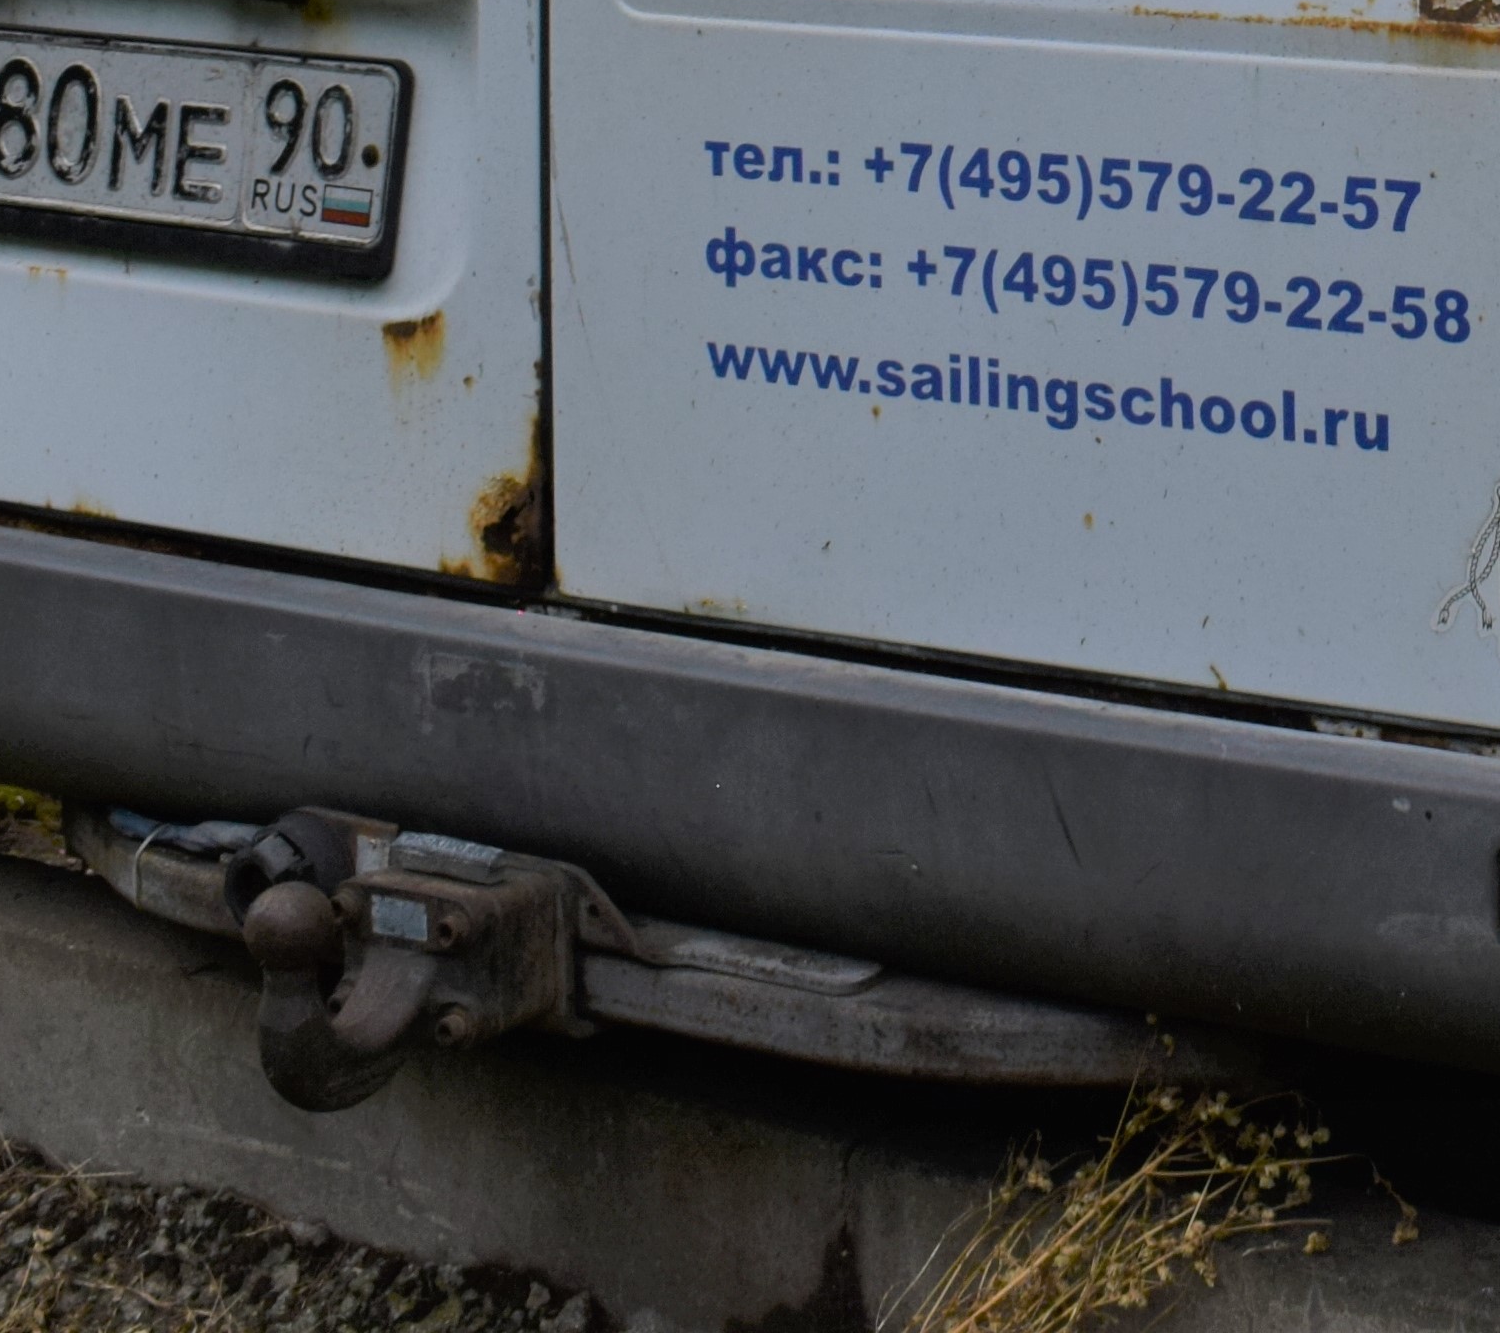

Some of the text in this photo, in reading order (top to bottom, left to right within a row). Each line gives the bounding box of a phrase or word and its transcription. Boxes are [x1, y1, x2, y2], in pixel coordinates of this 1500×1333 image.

[264, 77, 357, 179] 90
[251, 178, 319, 218] RUS
[703, 141, 1423, 234] тел.: +7(495)579-22-57
[704, 226, 1472, 346] факс: +7(495)579-22-58
[706, 341, 1391, 453] www.sailingschool.ru
